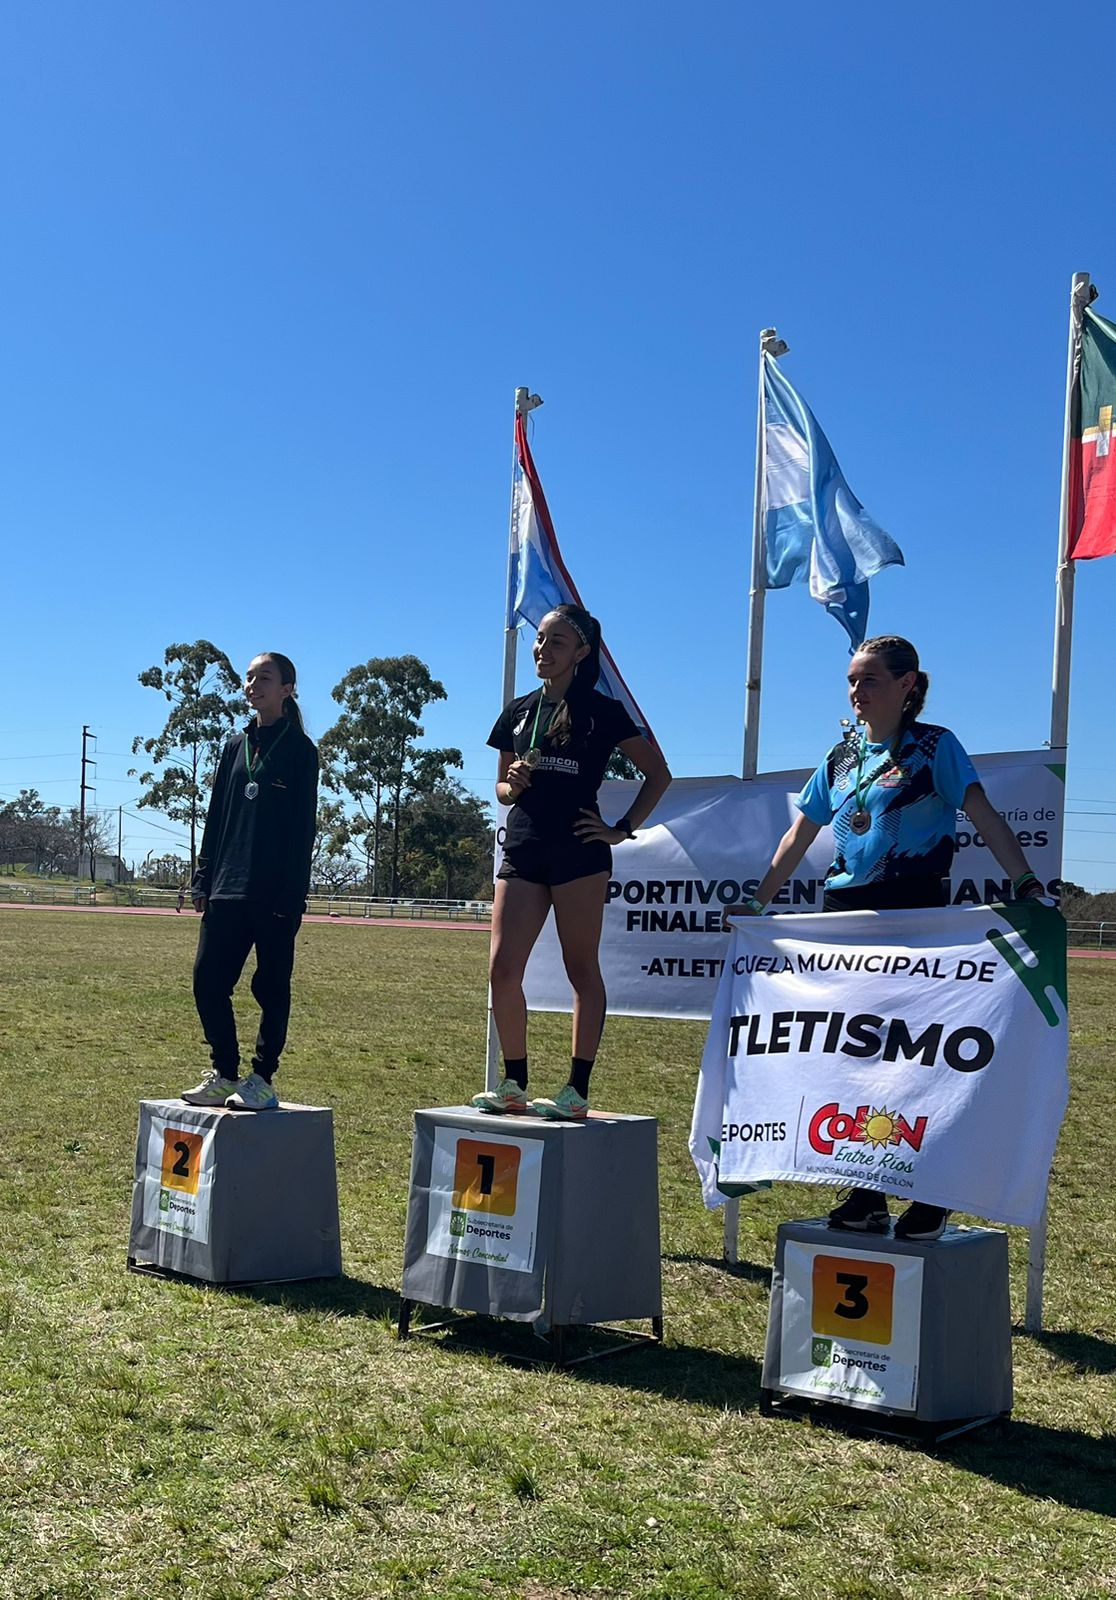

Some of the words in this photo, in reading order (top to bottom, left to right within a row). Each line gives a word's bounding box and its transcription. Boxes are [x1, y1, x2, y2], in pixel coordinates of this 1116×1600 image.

[1033, 807, 1056, 821] de
[797, 952, 947, 979] MUNICIPAL
[955, 959, 998, 983] DE
[172, 1141, 190, 1178] 2
[834, 1145, 875, 1166] Entre
[878, 1152, 915, 1174] Ríos
[477, 1154, 495, 1195] 1
[866, 1171, 880, 1182] DE
[169, 1201, 196, 1216] Deportes
[466, 1224, 511, 1241] Deportes
[833, 1271, 869, 1320] 3
[832, 1353, 887, 1373] Deportes
[880, 1353, 891, 1362] de
